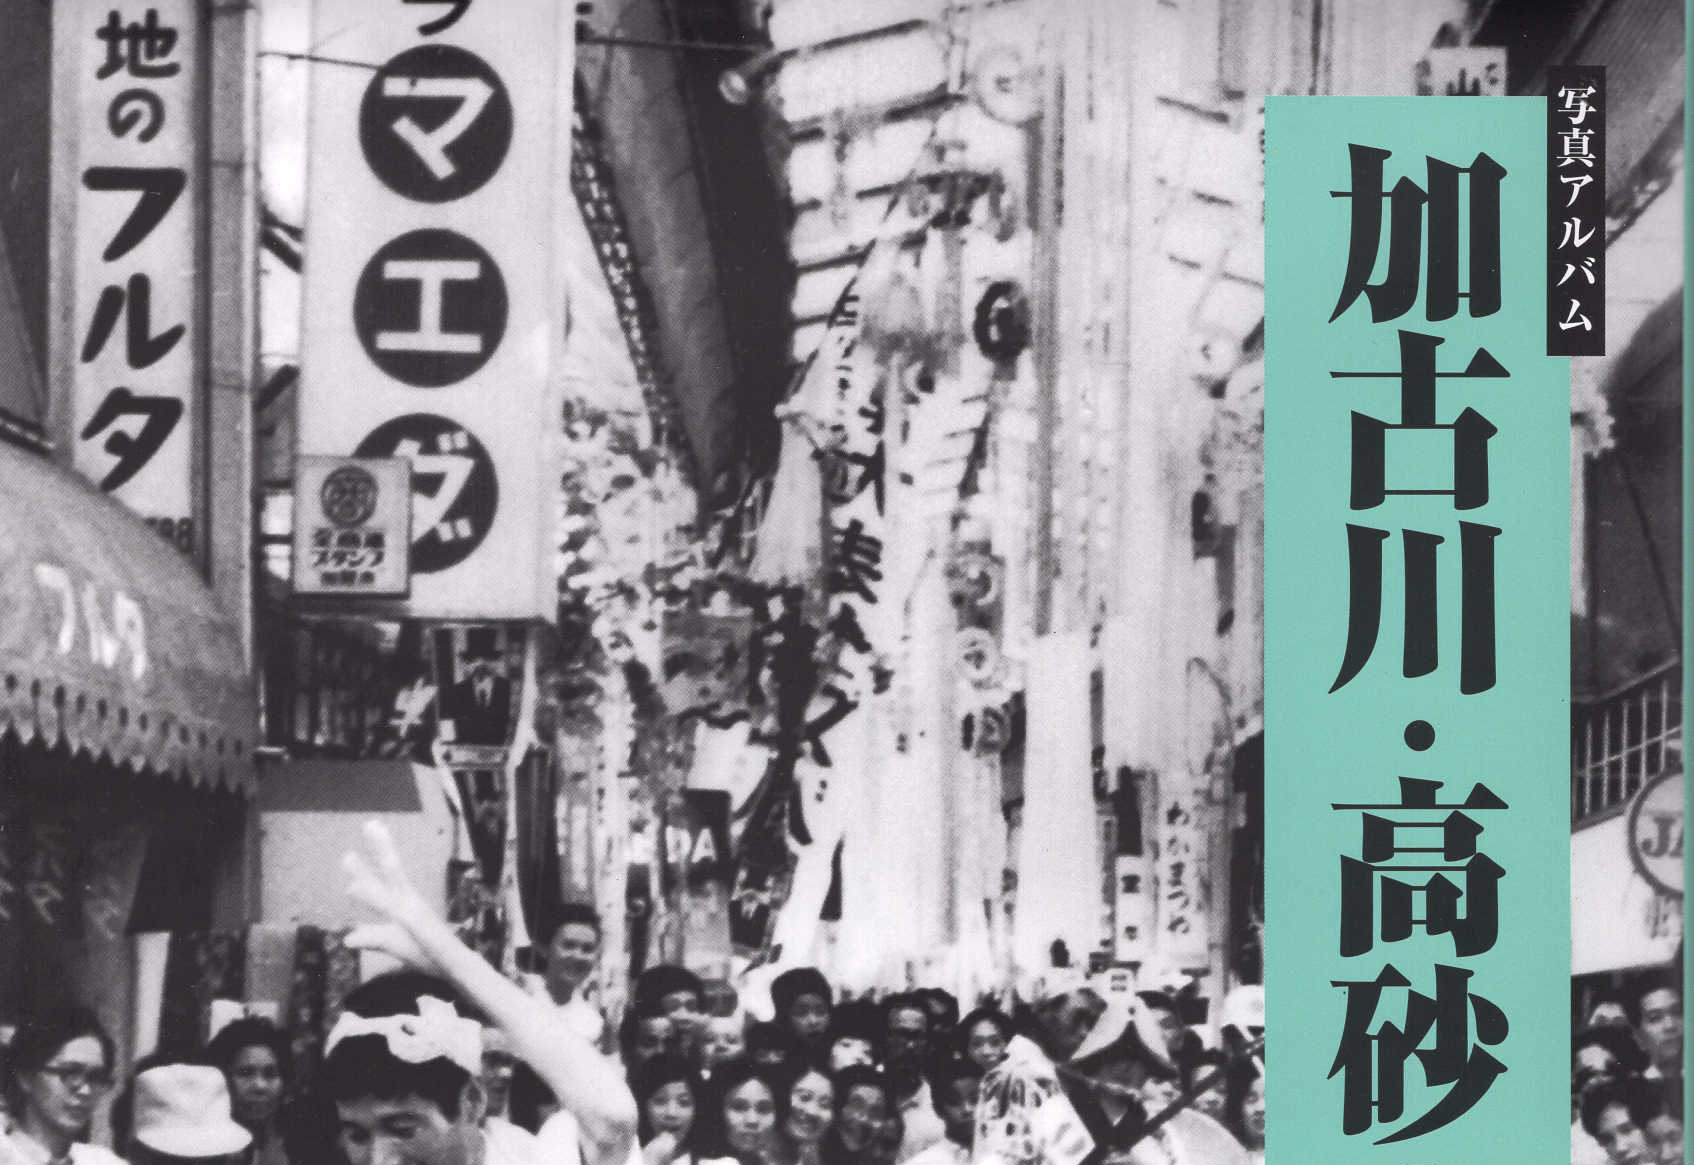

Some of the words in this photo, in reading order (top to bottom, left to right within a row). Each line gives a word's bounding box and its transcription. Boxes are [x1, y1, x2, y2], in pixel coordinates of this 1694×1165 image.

[82, 8, 188, 492] 地のフルタ
